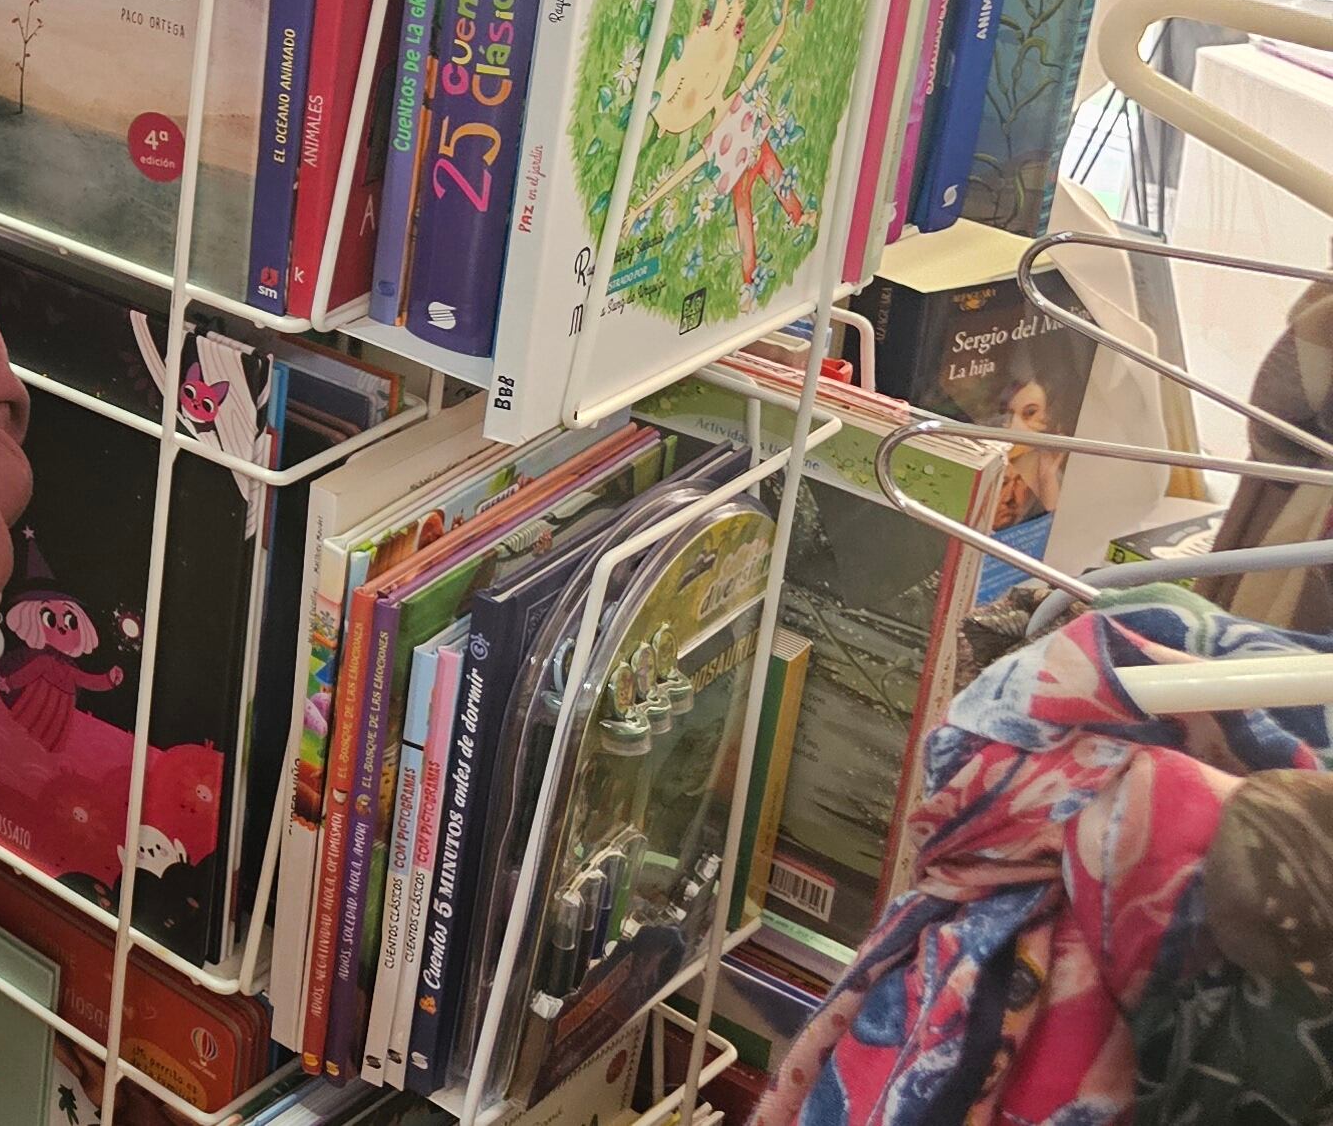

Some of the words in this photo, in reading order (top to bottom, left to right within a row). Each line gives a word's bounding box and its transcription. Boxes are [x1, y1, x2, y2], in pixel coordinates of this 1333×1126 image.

[120, 7, 144, 27] PACO
[149, 15, 186, 39] ORTEGA
[279, 27, 296, 87] ANIMADO
[275, 88, 291, 146] OCÉANO
[303, 93, 325, 168] ANIMALES
[139, 153, 176, 170] edición
[273, 147, 286, 164] EL
[431, 114, 503, 214] 25
[256, 284, 278, 300] sm
[951, 327, 1010, 358] Sergio
[1010, 317, 1037, 342] del
[493, 374, 516, 411] BBB
[948, 362, 967, 382] La
[966, 359, 996, 383] hija
[461, 667, 485, 735] dormir
[460, 735, 476, 760] de
[395, 765, 417, 842] PICTOGRAMAS
[419, 759, 442, 838] PICTOGRAMAS
[452, 759, 474, 812] antes
[394, 844, 409, 870] CON
[416, 837, 430, 864] CON
[438, 813, 466, 900] MINUTOS
[390, 875, 404, 920] CLÁSICOS
[410, 871, 426, 916] CLÁSICOS
[433, 897, 453, 920] 5
[384, 918, 401, 971] CUENTOS
[405, 912, 423, 964] CUENTOS
[421, 917, 450, 991] Cuentos
